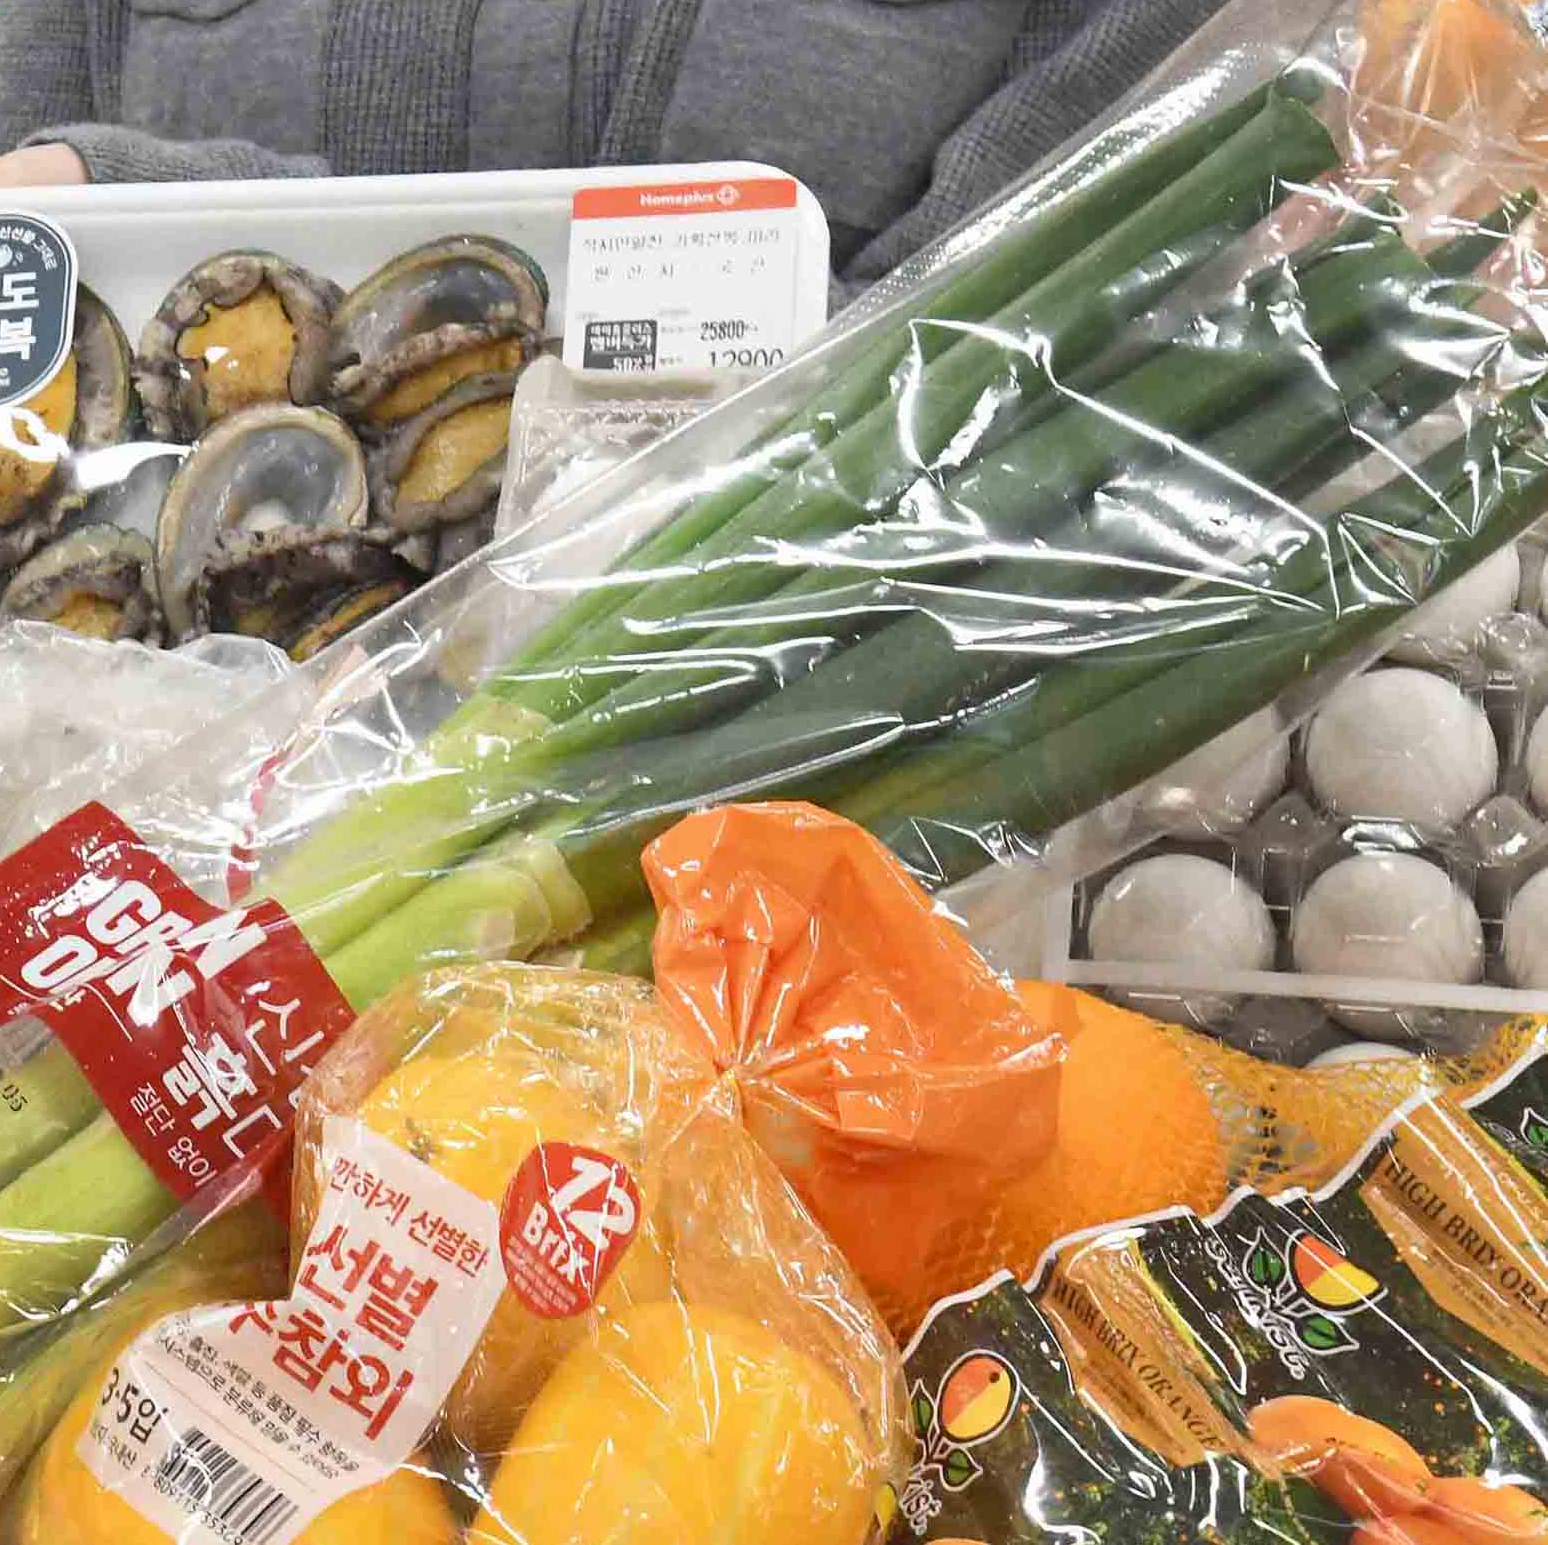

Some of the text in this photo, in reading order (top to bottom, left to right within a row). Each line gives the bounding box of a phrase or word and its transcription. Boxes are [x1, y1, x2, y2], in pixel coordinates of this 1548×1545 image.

[639, 188, 715, 208] Homeplus
[700, 320, 745, 343] 25800
[128, 1082, 219, 1189] 절단 없이
[411, 1207, 490, 1281] 선별한
[1384, 1158, 1448, 1221] HIGH
[1443, 1212, 1503, 1273] BRIX
[300, 1224, 440, 1352] 선별
[1050, 1277, 1227, 1455] HIGH BRIX ORANGE
